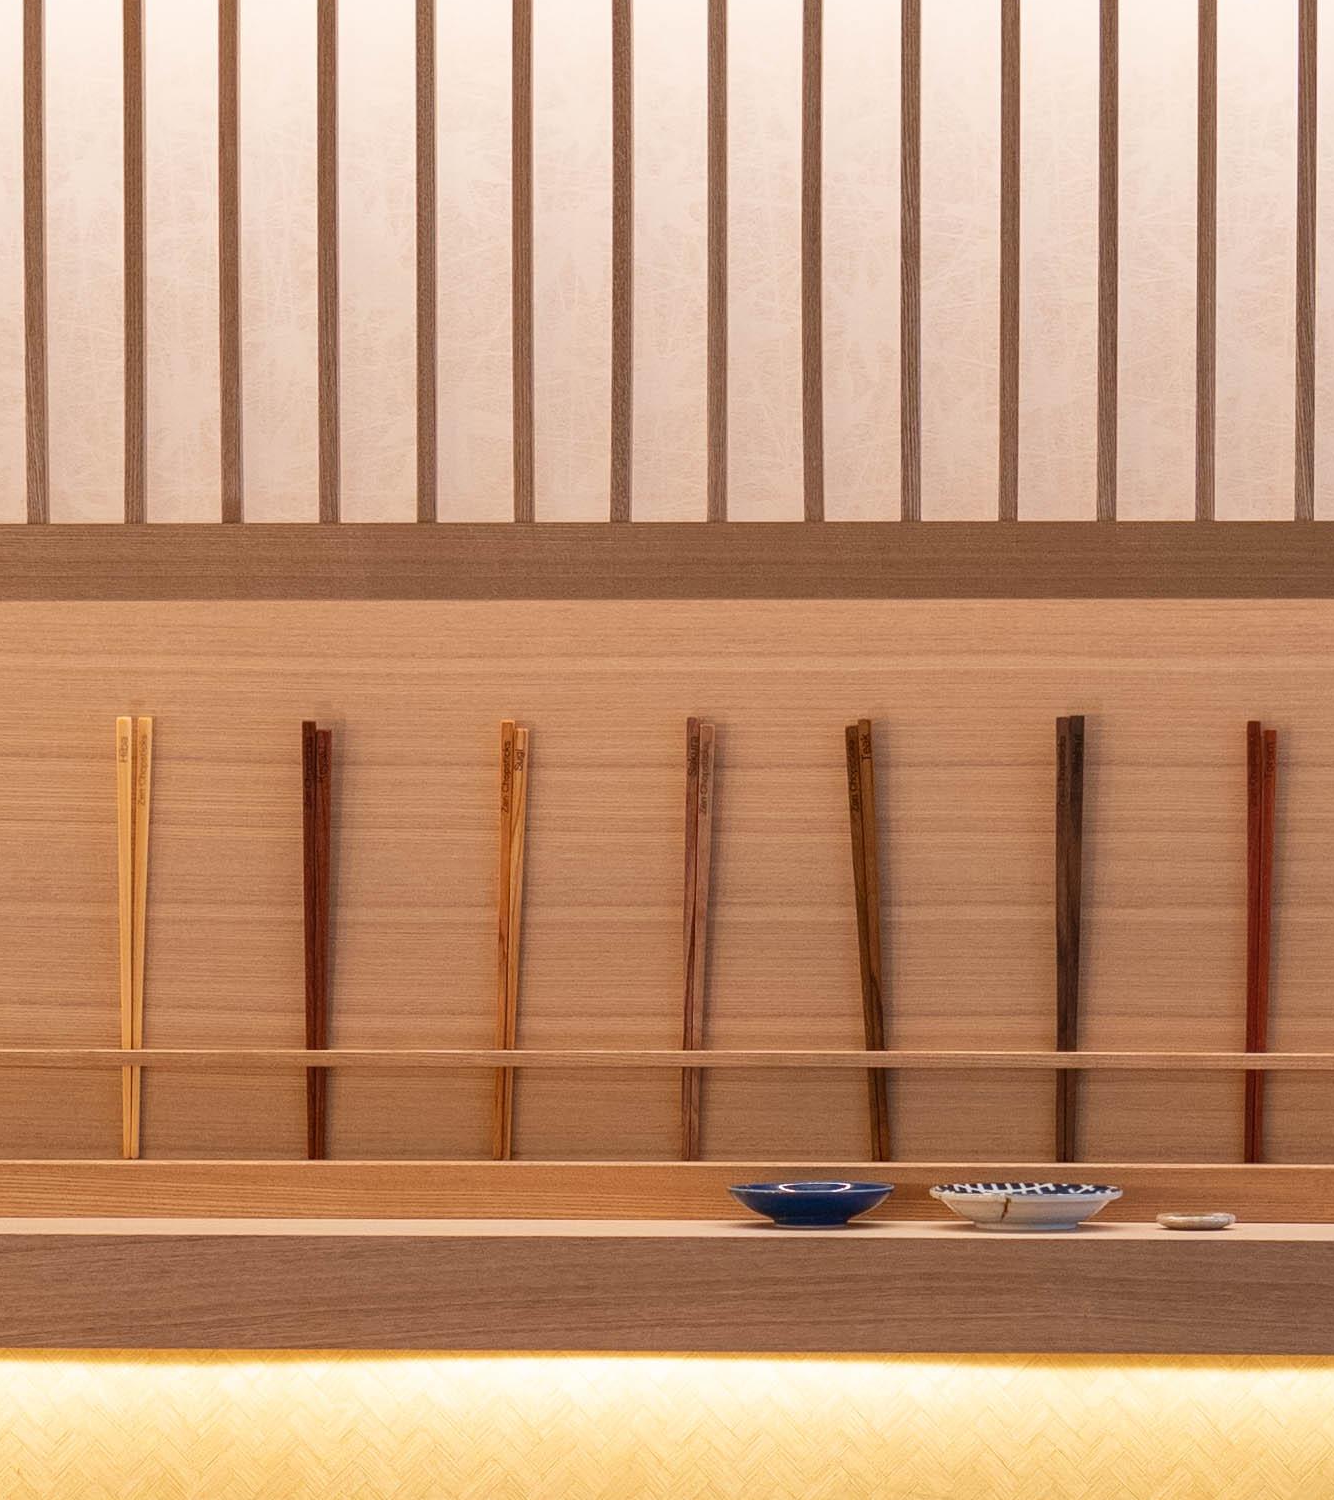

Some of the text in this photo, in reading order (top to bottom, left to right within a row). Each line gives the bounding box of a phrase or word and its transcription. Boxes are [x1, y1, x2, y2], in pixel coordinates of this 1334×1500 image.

[118, 736, 128, 763] Hiba
[514, 749, 525, 771] Sugi
[860, 733, 871, 762] Teak
